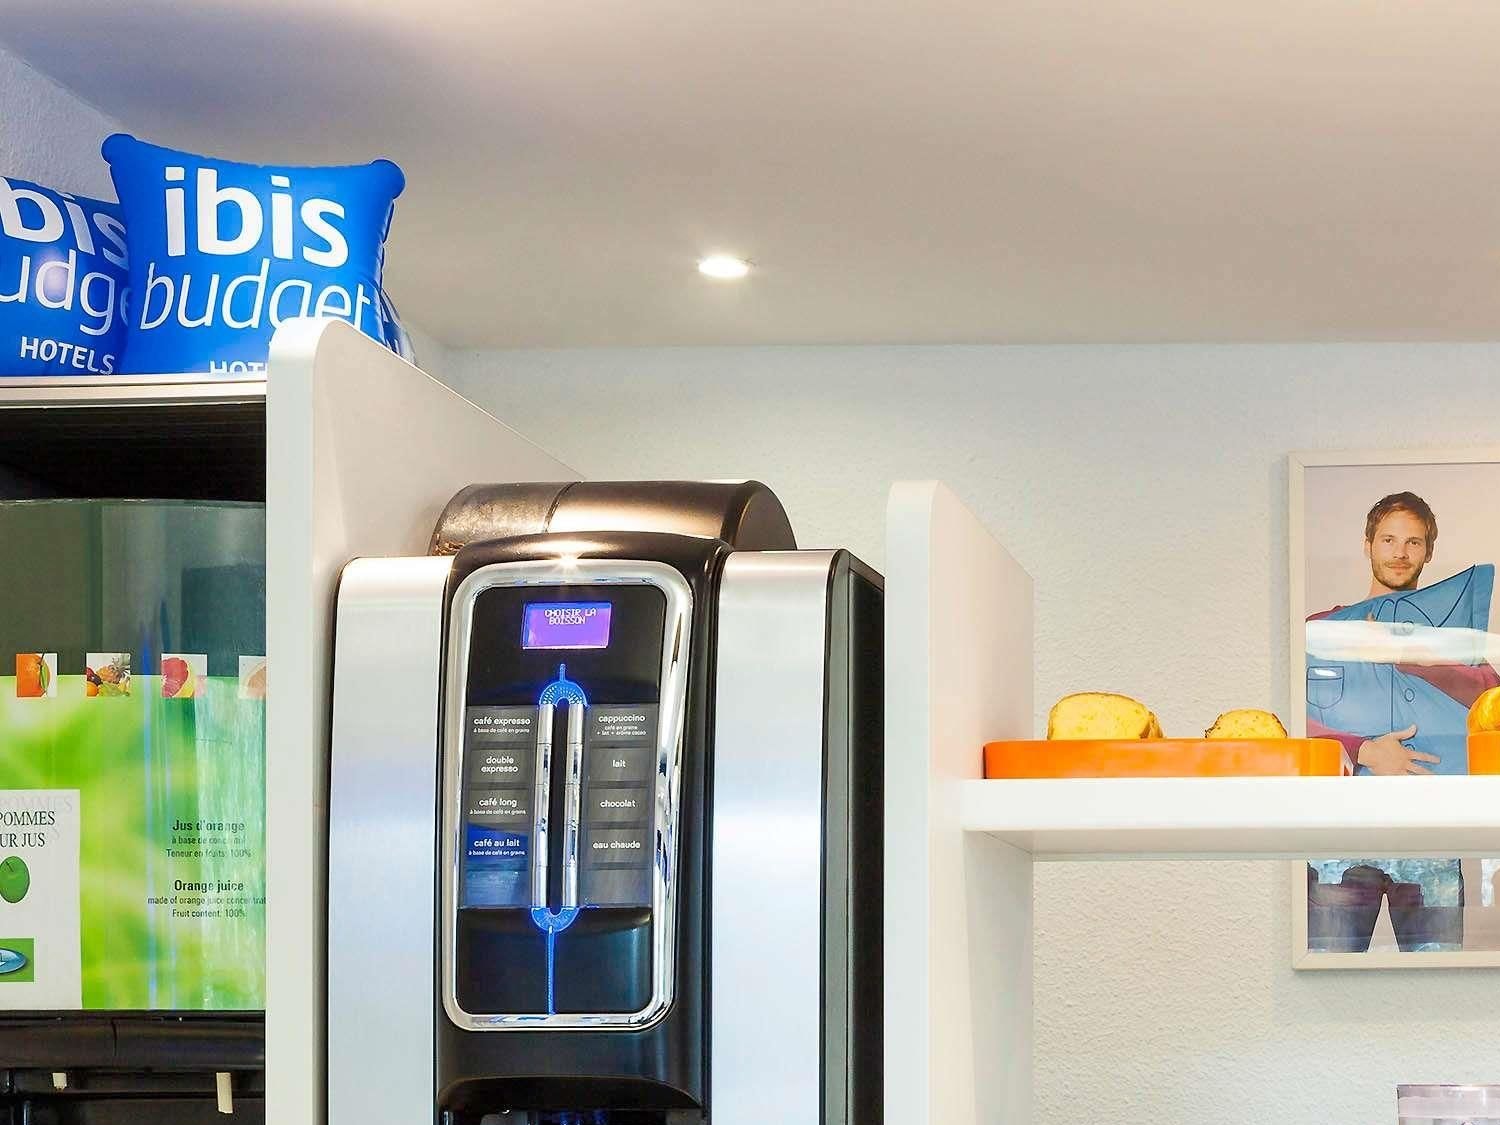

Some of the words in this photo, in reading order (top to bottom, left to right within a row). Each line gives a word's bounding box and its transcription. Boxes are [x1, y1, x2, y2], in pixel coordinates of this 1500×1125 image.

[164, 166, 349, 268] ibis
[139, 258, 371, 331] budget
[20, 336, 115, 376] HOTELS
[545, 608, 582, 618] CHOISIR
[585, 608, 597, 617] LA
[549, 616, 586, 625] BOISSON
[474, 716, 492, 725] café
[494, 717, 531, 727] expresso
[598, 714, 646, 724] cappuccino
[486, 755, 514, 765] double
[612, 759, 626, 768] lait
[480, 765, 518, 776] expresso
[479, 797, 497, 807] café
[499, 797, 517, 809] long
[600, 799, 636, 809] chocolat
[172, 819, 193, 831] Jus
[196, 819, 245, 834] d'orange
[21, 832, 46, 848] JUS
[178, 836, 196, 845] base
[474, 838, 492, 847] café
[506, 838, 520, 847] lait
[592, 841, 608, 849] eau
[609, 839, 640, 849] chaude
[166, 848, 193, 858] Teneur
[194, 850, 203, 858] en
[174, 879, 214, 893] Orange
[217, 879, 244, 894] juice
[147, 896, 168, 904] made
[170, 895, 177, 904] of
[172, 909, 189, 918] Fruit
